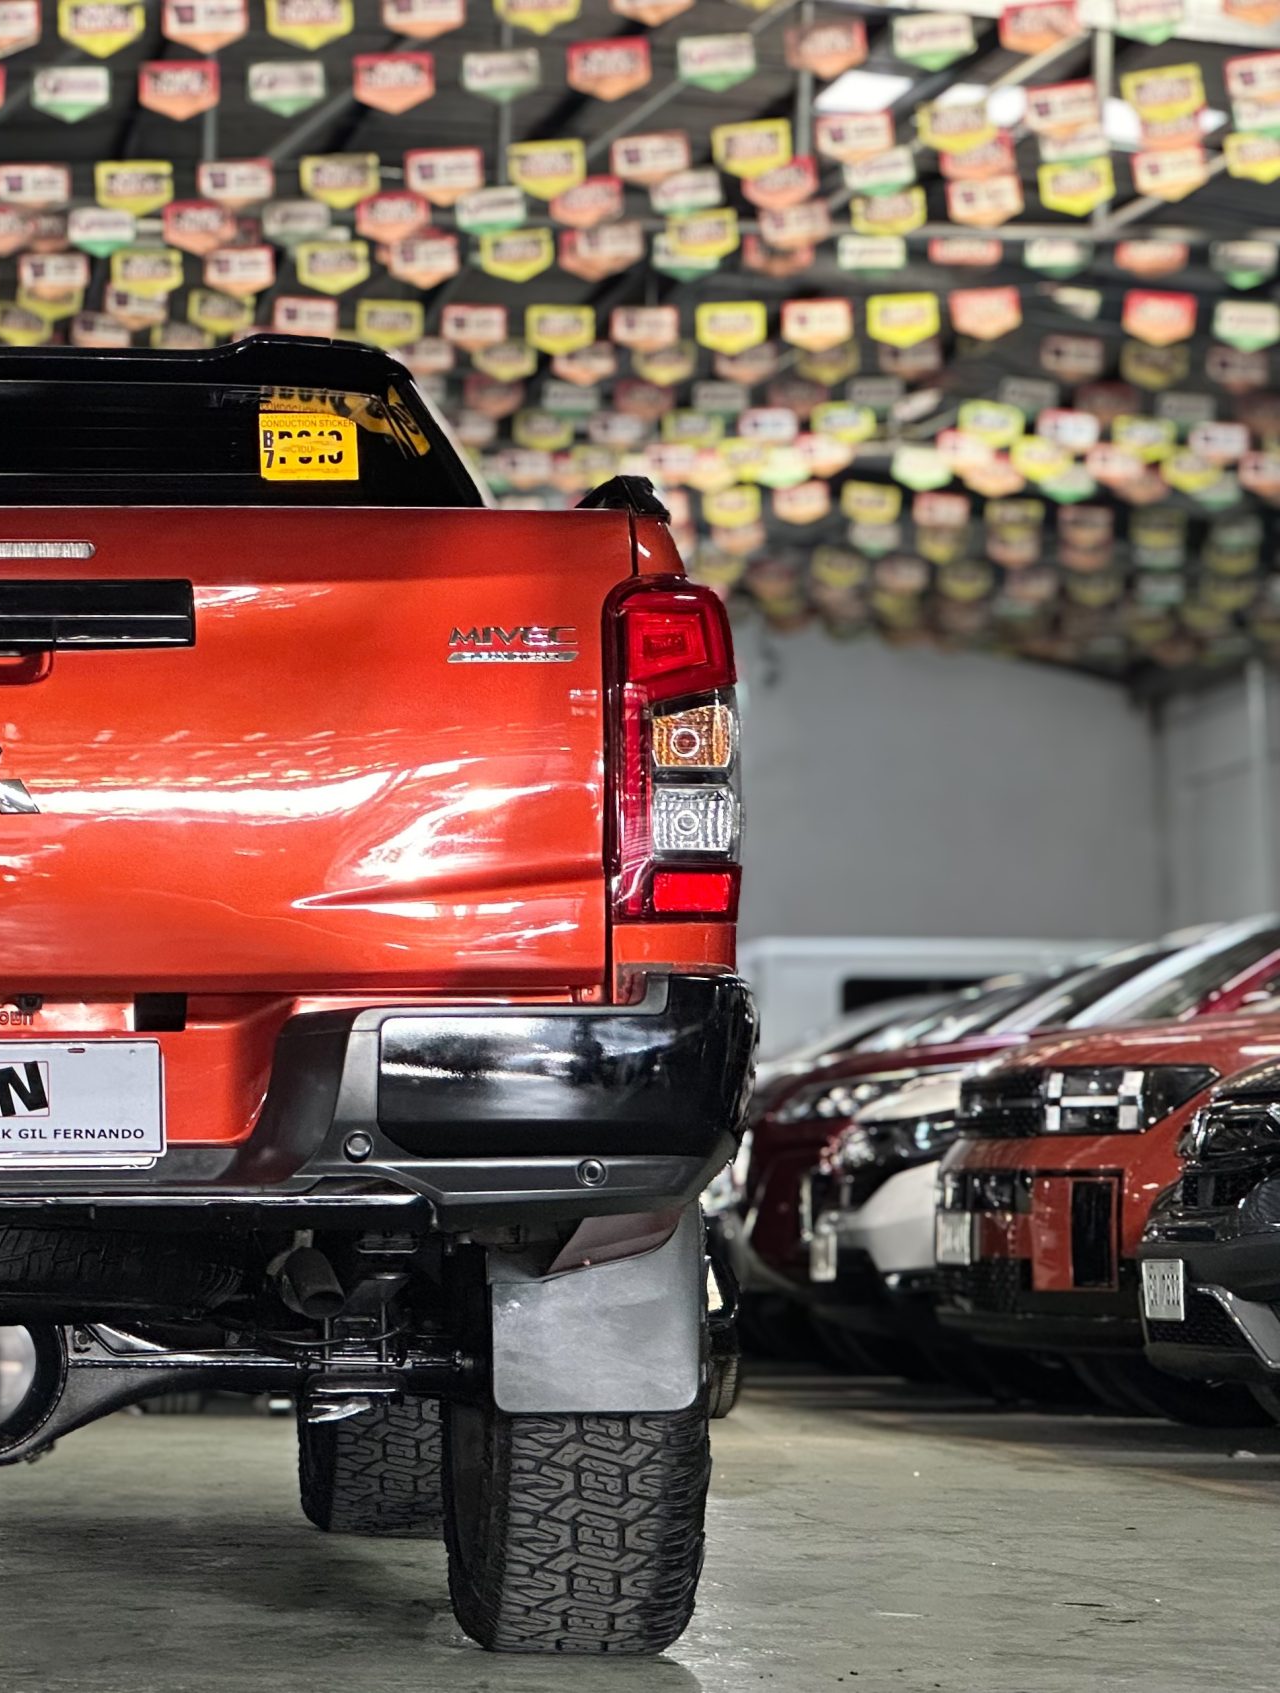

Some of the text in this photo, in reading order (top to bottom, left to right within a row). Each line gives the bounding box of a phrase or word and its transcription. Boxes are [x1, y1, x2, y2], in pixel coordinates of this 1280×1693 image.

[261, 420, 354, 428] CONDUCTION STICKER
[448, 626, 578, 646] MIVEC
[18, 1128, 47, 1140] GIL
[53, 1128, 145, 1140] FERNANDO
